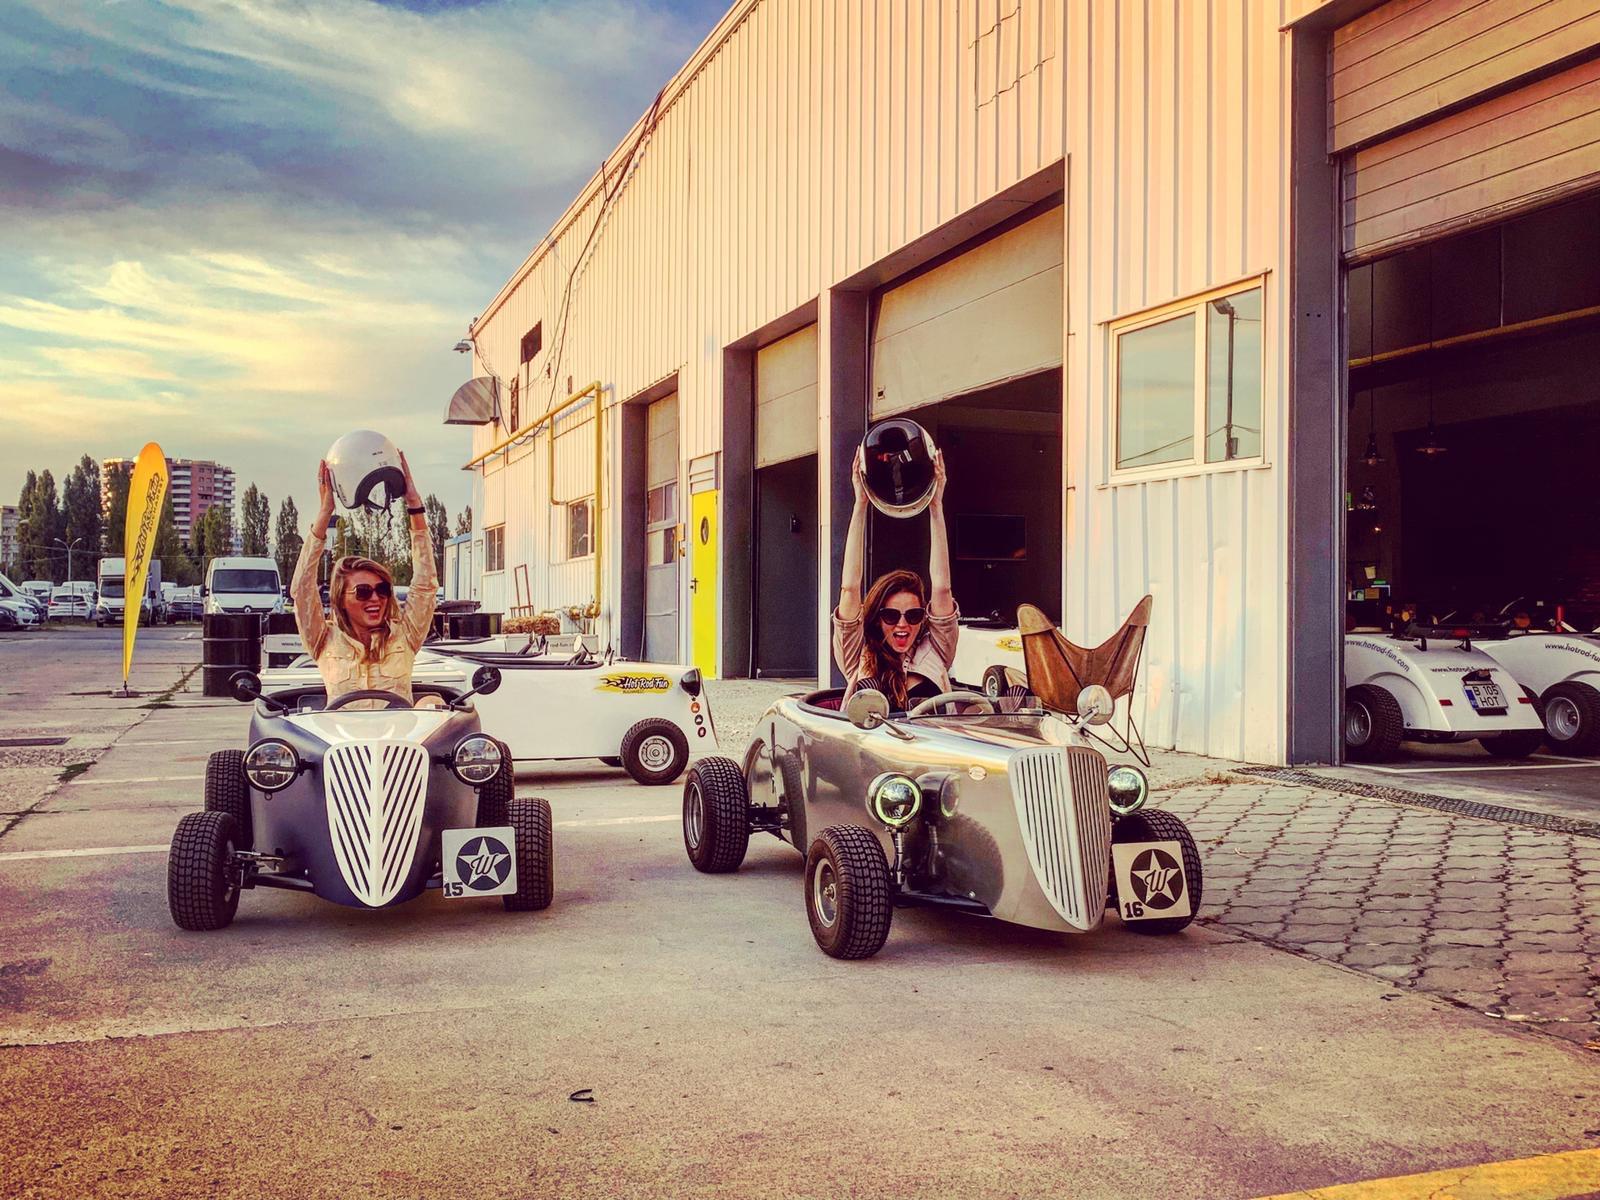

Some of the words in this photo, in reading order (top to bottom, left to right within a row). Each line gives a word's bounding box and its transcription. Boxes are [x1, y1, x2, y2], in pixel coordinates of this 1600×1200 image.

[624, 677, 638, 689] Hot
[639, 678, 654, 689] Rod
[654, 677, 669, 689] Fun
[1472, 686, 1481, 696] B
[1483, 685, 1499, 696] 105
[1480, 696, 1499, 707] HOT
[443, 882, 463, 897] 15
[1124, 901, 1144, 918] 16
